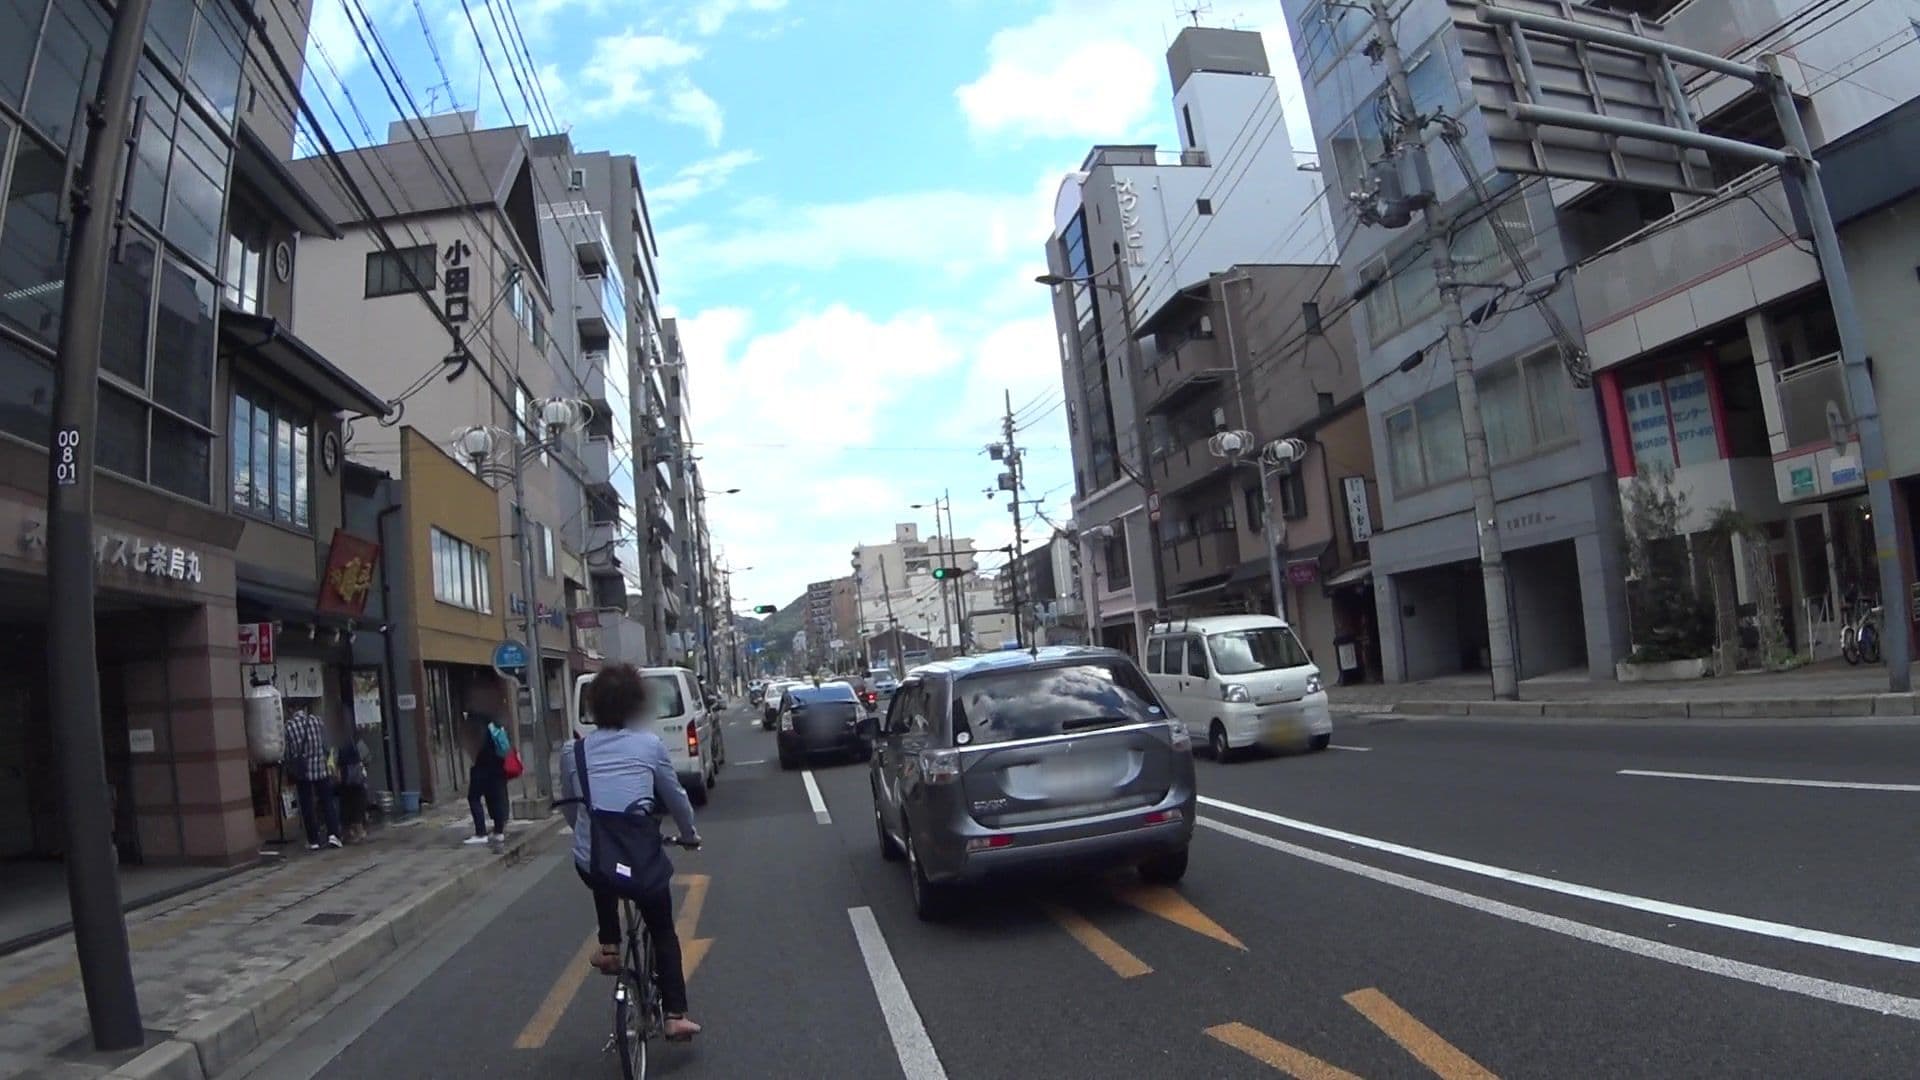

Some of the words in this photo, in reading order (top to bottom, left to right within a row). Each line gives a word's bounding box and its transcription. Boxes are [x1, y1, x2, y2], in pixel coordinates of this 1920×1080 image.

[58, 430, 80, 447] 00
[62, 446, 73, 463] 8
[57, 463, 76, 480] 01
